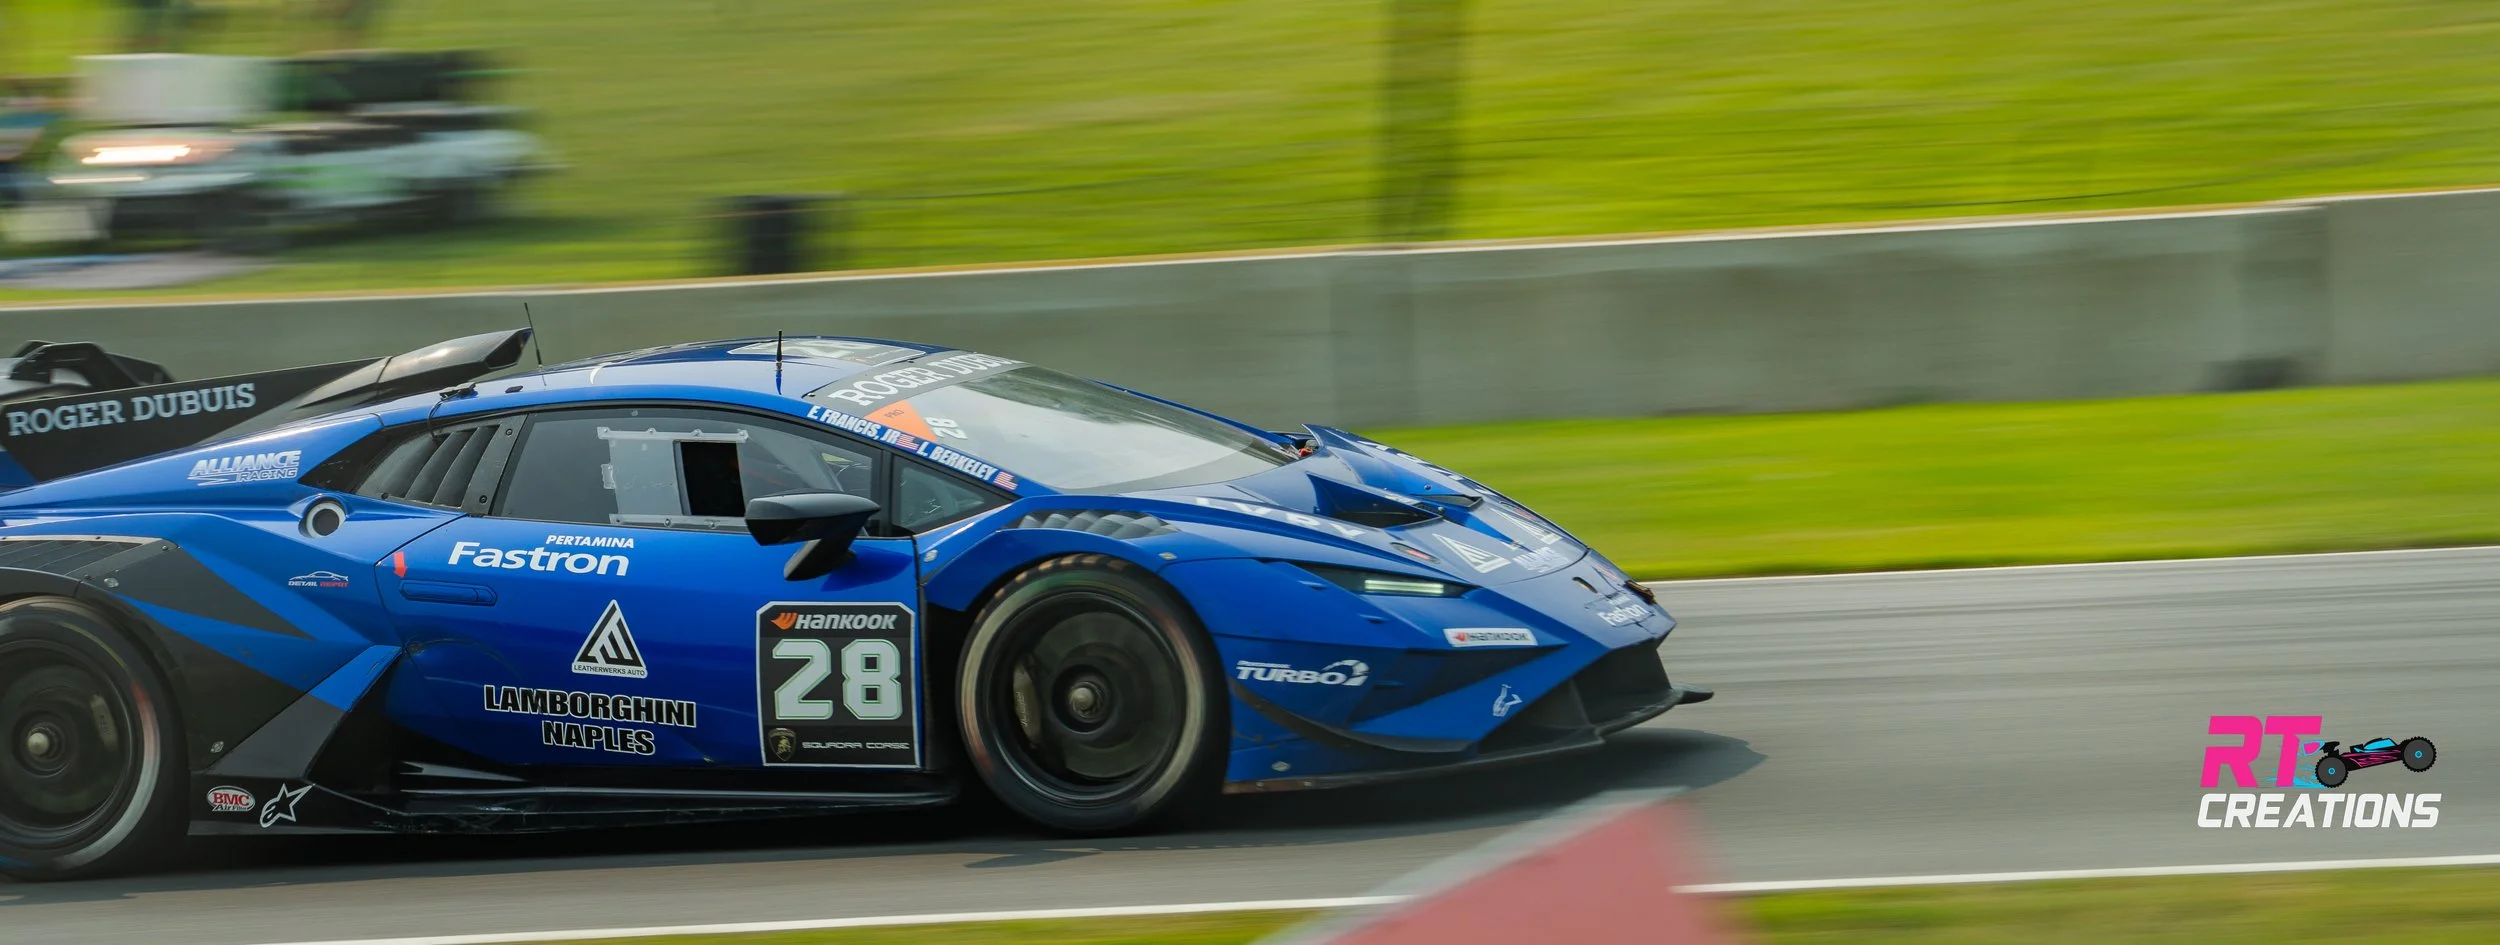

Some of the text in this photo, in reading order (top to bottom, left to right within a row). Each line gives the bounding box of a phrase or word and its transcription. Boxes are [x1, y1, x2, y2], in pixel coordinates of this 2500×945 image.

[828, 367, 954, 406] ROGER
[7, 383, 256, 436] ROGER DUBUIS
[820, 409, 881, 440] FRANCIS,
[188, 450, 302, 477] ALLIANCE
[239, 468, 299, 482] RACING
[929, 446, 999, 480] BERKELEY
[545, 534, 635, 549] PERTAMINA
[447, 541, 630, 577] Fastron
[573, 664, 626, 675] LEATHERWERKS
[772, 639, 903, 720] 28
[1236, 666, 1347, 685] TURBO
[483, 684, 697, 728] LAMBORGHINI
[541, 720, 656, 756] NAPLES
[212, 792, 250, 806] BMC
